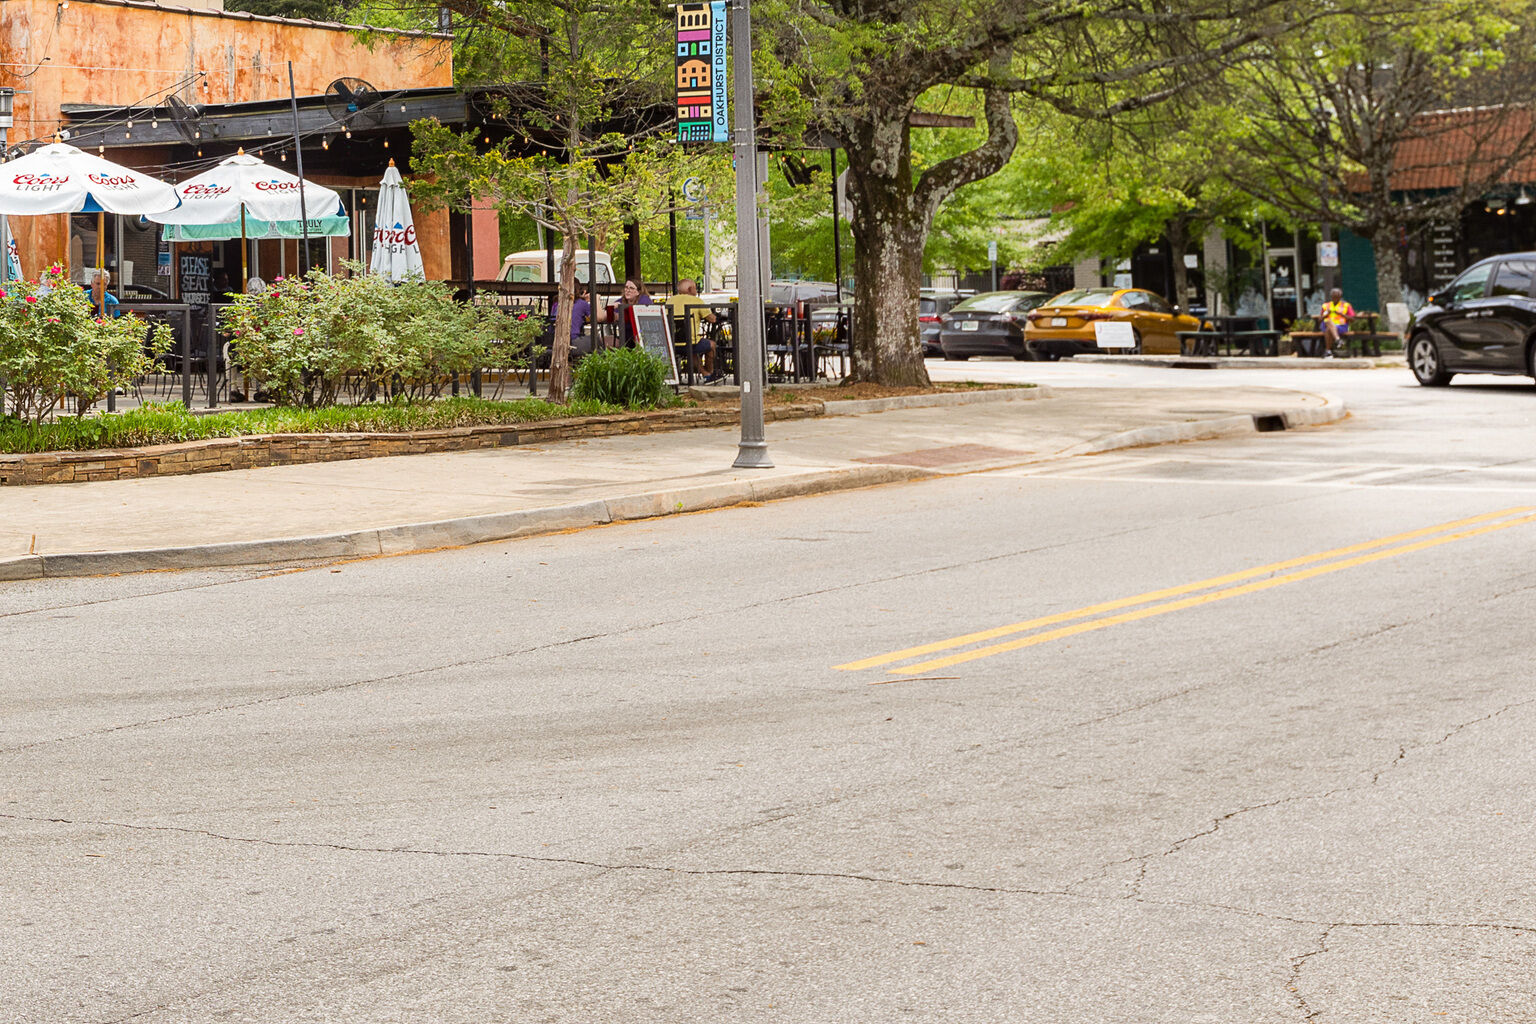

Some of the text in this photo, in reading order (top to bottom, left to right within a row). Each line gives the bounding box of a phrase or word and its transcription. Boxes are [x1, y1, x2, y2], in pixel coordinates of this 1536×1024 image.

[715, 18, 725, 126] OAKHURST DISTRICT
[13, 174, 69, 185] Coors
[88, 173, 136, 186] Coors
[16, 183, 64, 192] LIGHT
[183, 184, 232, 195] Coors
[296, 219, 323, 228] TULY
[181, 256, 210, 276] PLEASE
[182, 276, 209, 292] SEAT
